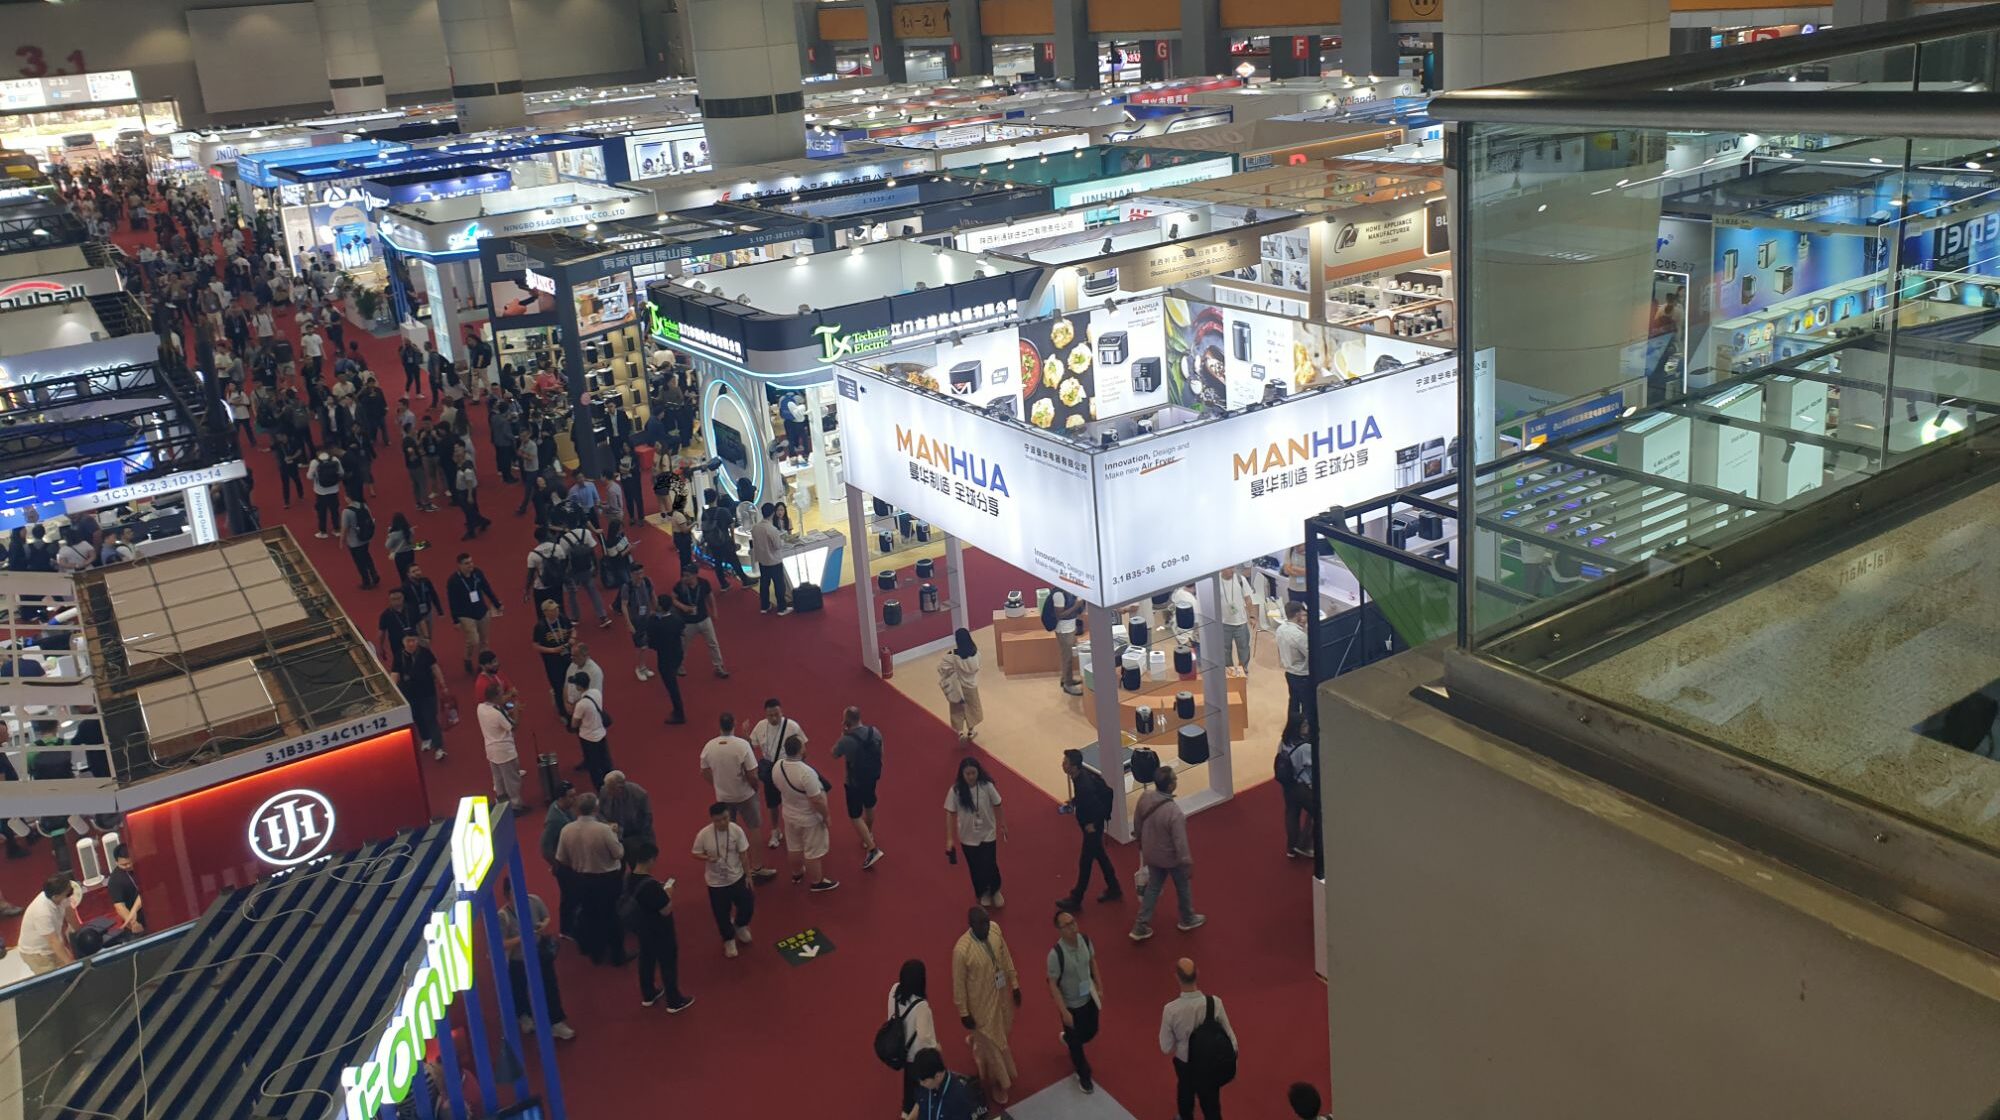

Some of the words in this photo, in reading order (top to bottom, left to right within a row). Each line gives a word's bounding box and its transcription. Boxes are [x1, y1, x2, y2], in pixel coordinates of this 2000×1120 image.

[1157, 41, 1167, 58] G
[1296, 39, 1305, 56] F
[16, 46, 87, 77] 3.1
[503, 221, 535, 232] NINGBO
[1384, 218, 1412, 229] APPLIANCE
[853, 339, 889, 354] Electric
[1104, 454, 1151, 472] Innovation,
[1152, 446, 1177, 459] Design
[1177, 442, 1190, 451] and
[1232, 415, 1383, 481] MANHUA
[896, 424, 1010, 498] MANHUA
[1104, 470, 1125, 481] Make
[1125, 466, 1140, 475] new
[1141, 462, 1154, 470] Air
[1250, 467, 1309, 499] 曼华制造
[1314, 448, 1369, 480] 全球分享
[909, 461, 951, 496] 曼华制造
[954, 481, 1000, 517] 全球分享
[1161, 554, 1190, 569] C09-10
[265, 716, 388, 764] 3.1B33-34C11-12
[790, 935, 815, 950] EXIT
